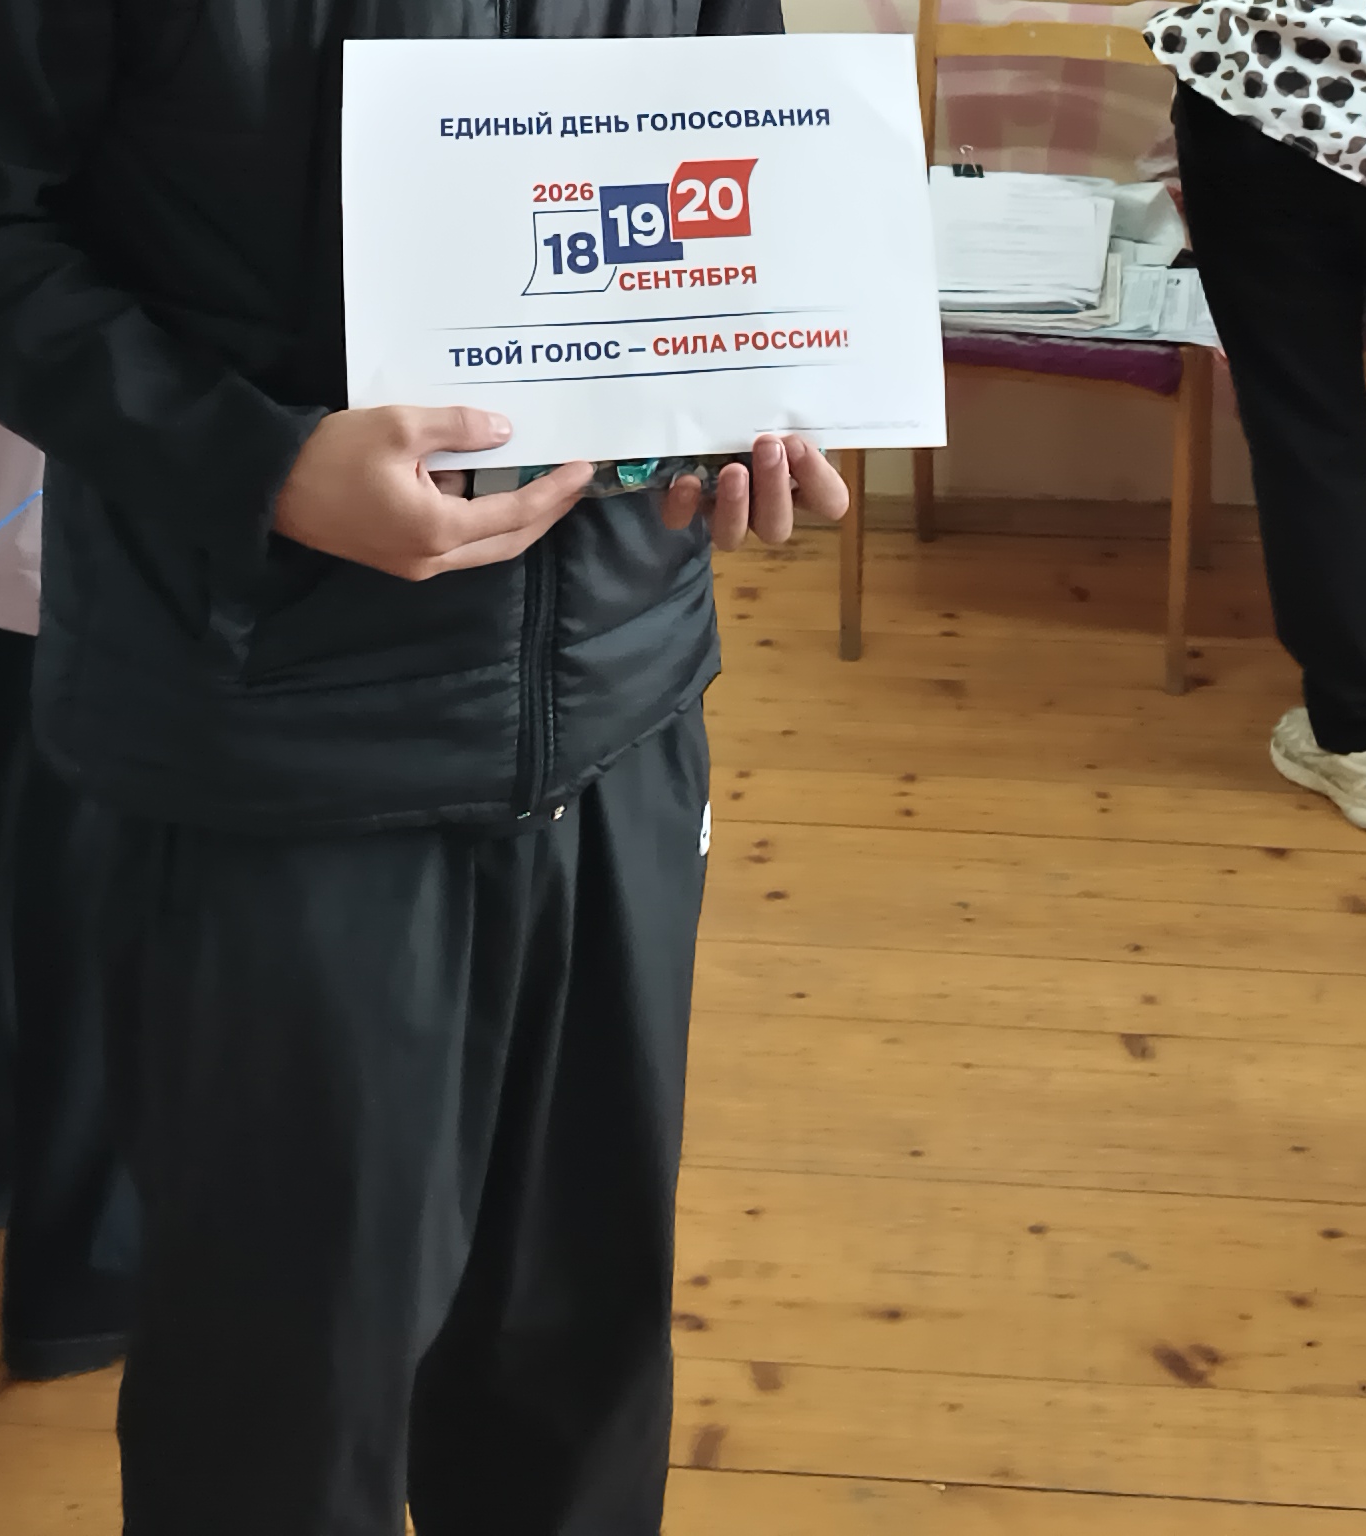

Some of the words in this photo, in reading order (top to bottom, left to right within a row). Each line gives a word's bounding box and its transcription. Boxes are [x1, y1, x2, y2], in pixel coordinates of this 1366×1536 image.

[441, 112, 552, 139] ЕДИНЫЙ
[561, 115, 629, 137] ДЕНЬ
[637, 109, 829, 132] ГОЛОСОВАНИЯ
[533, 183, 593, 202] 2026
[544, 232, 598, 274] 18
[609, 203, 664, 247] 19
[676, 178, 743, 222] 20
[619, 265, 756, 291] СЕНТЯБРЯ
[449, 340, 522, 367] ТВОЙ
[532, 341, 620, 363] ГОЛОС
[653, 334, 727, 356] СИЛА
[735, 330, 848, 351] РОССИИ!
